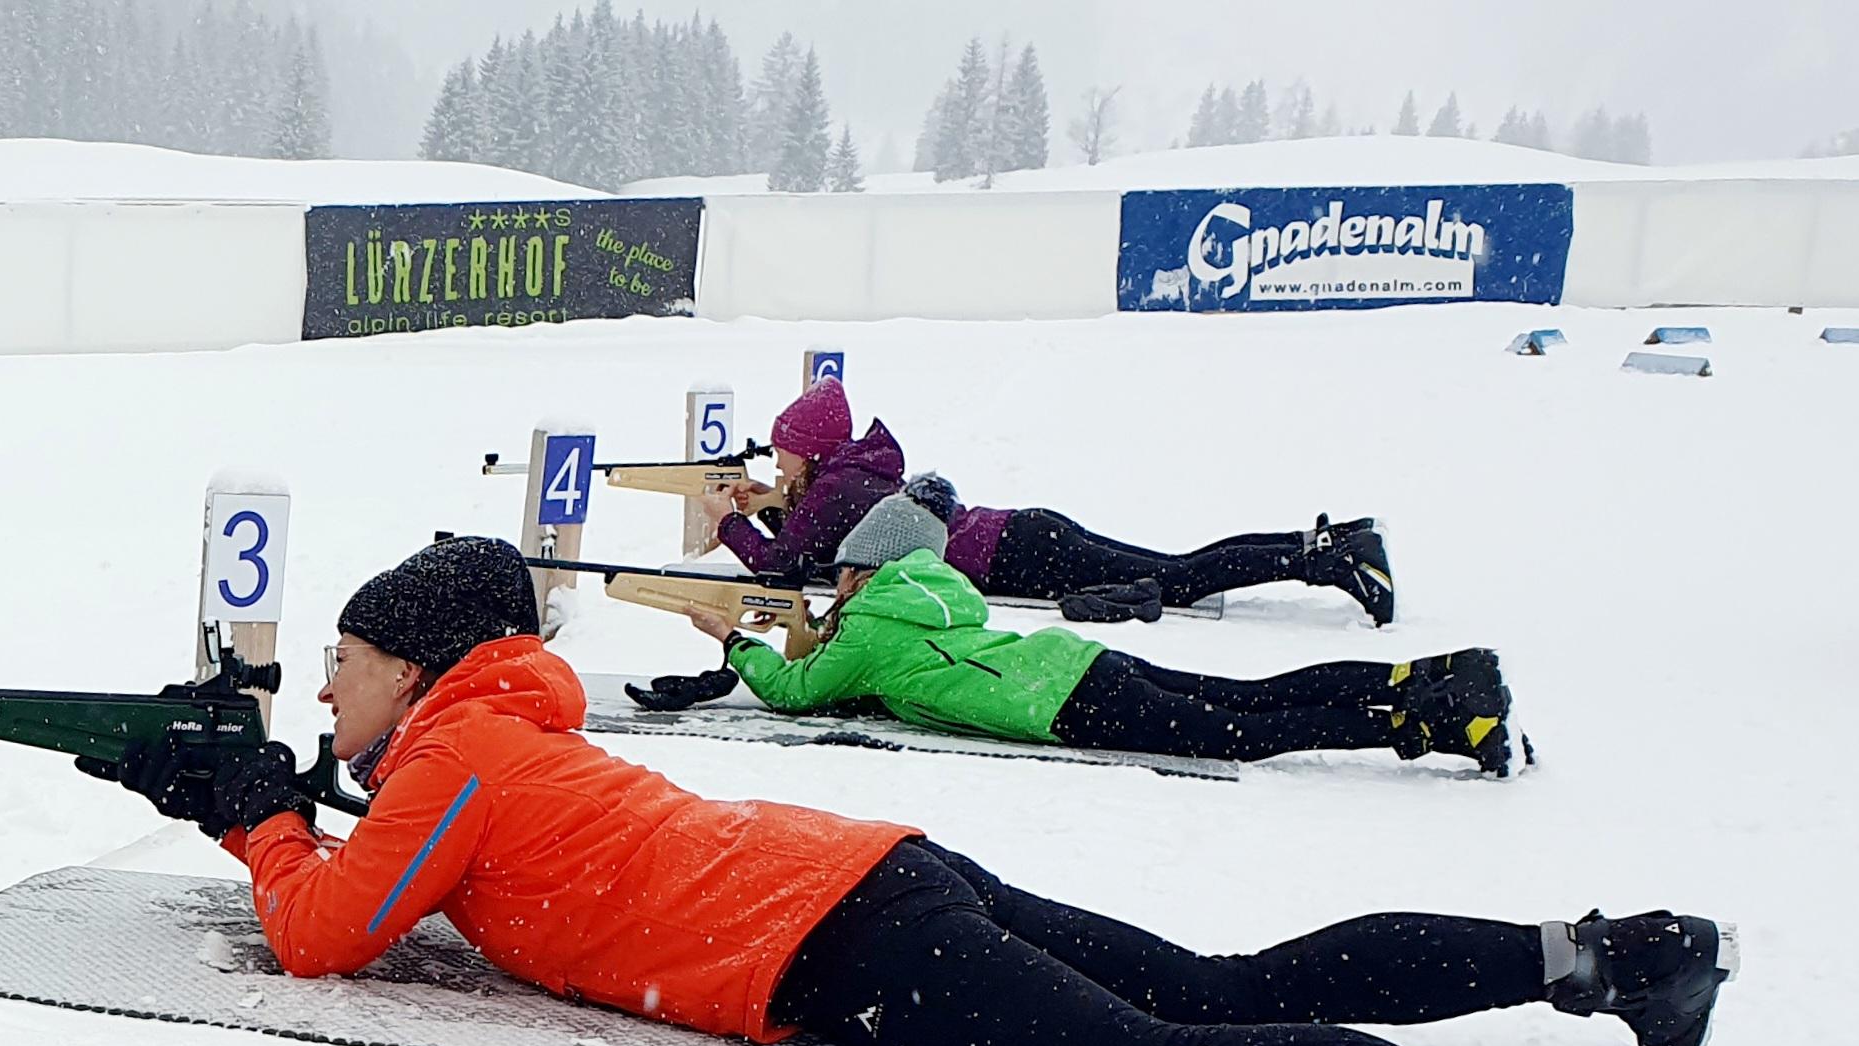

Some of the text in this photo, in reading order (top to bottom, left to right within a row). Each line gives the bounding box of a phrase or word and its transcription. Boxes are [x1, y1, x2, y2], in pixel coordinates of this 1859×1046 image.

[346, 230, 570, 305] LÜRZERHOF
[596, 228, 674, 271] the place
[1187, 200, 1485, 299] Gnadenalm
[609, 266, 653, 297] to be
[1258, 279, 1463, 295] www.gnadenalm.com
[347, 308, 569, 335] alpin life resort
[700, 403, 727, 455] 5
[545, 447, 582, 516] 4
[217, 510, 270, 608] 3
[216, 723, 244, 733] nior
